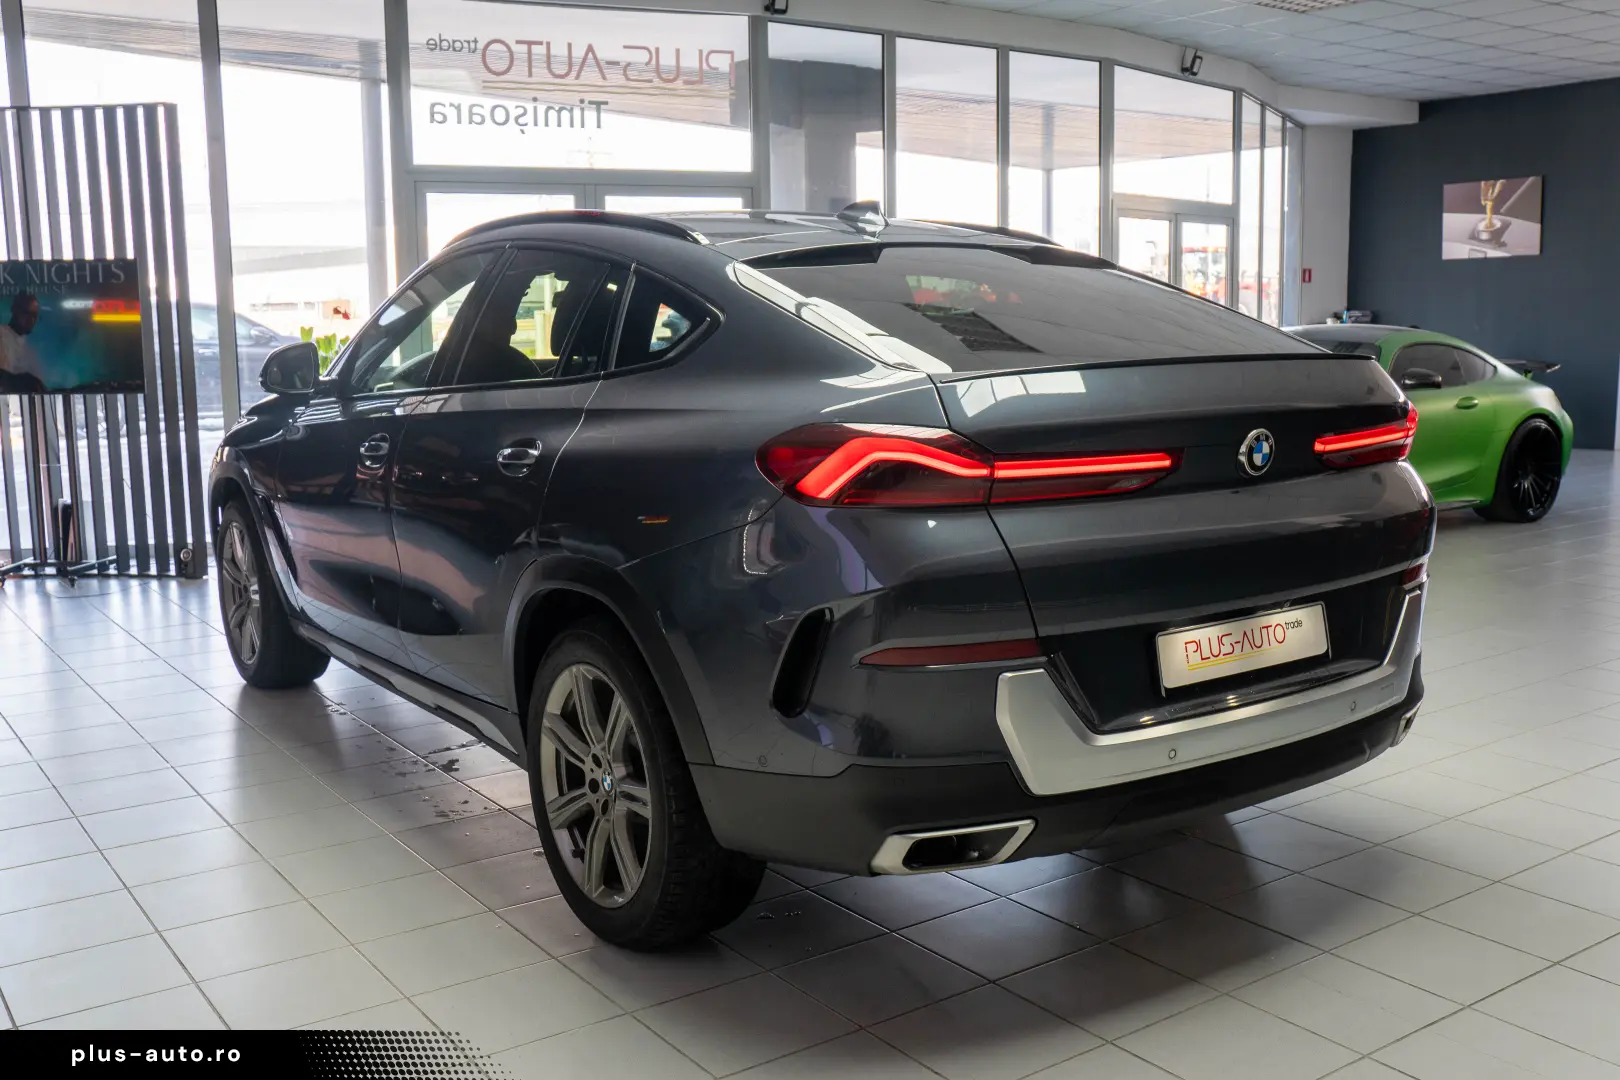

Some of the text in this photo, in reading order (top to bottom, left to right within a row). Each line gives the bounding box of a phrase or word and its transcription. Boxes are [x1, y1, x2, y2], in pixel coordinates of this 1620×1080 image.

[26, 262, 125, 284] NIGHTS
[1184, 617, 1303, 664] PLUS-AUTO trade
